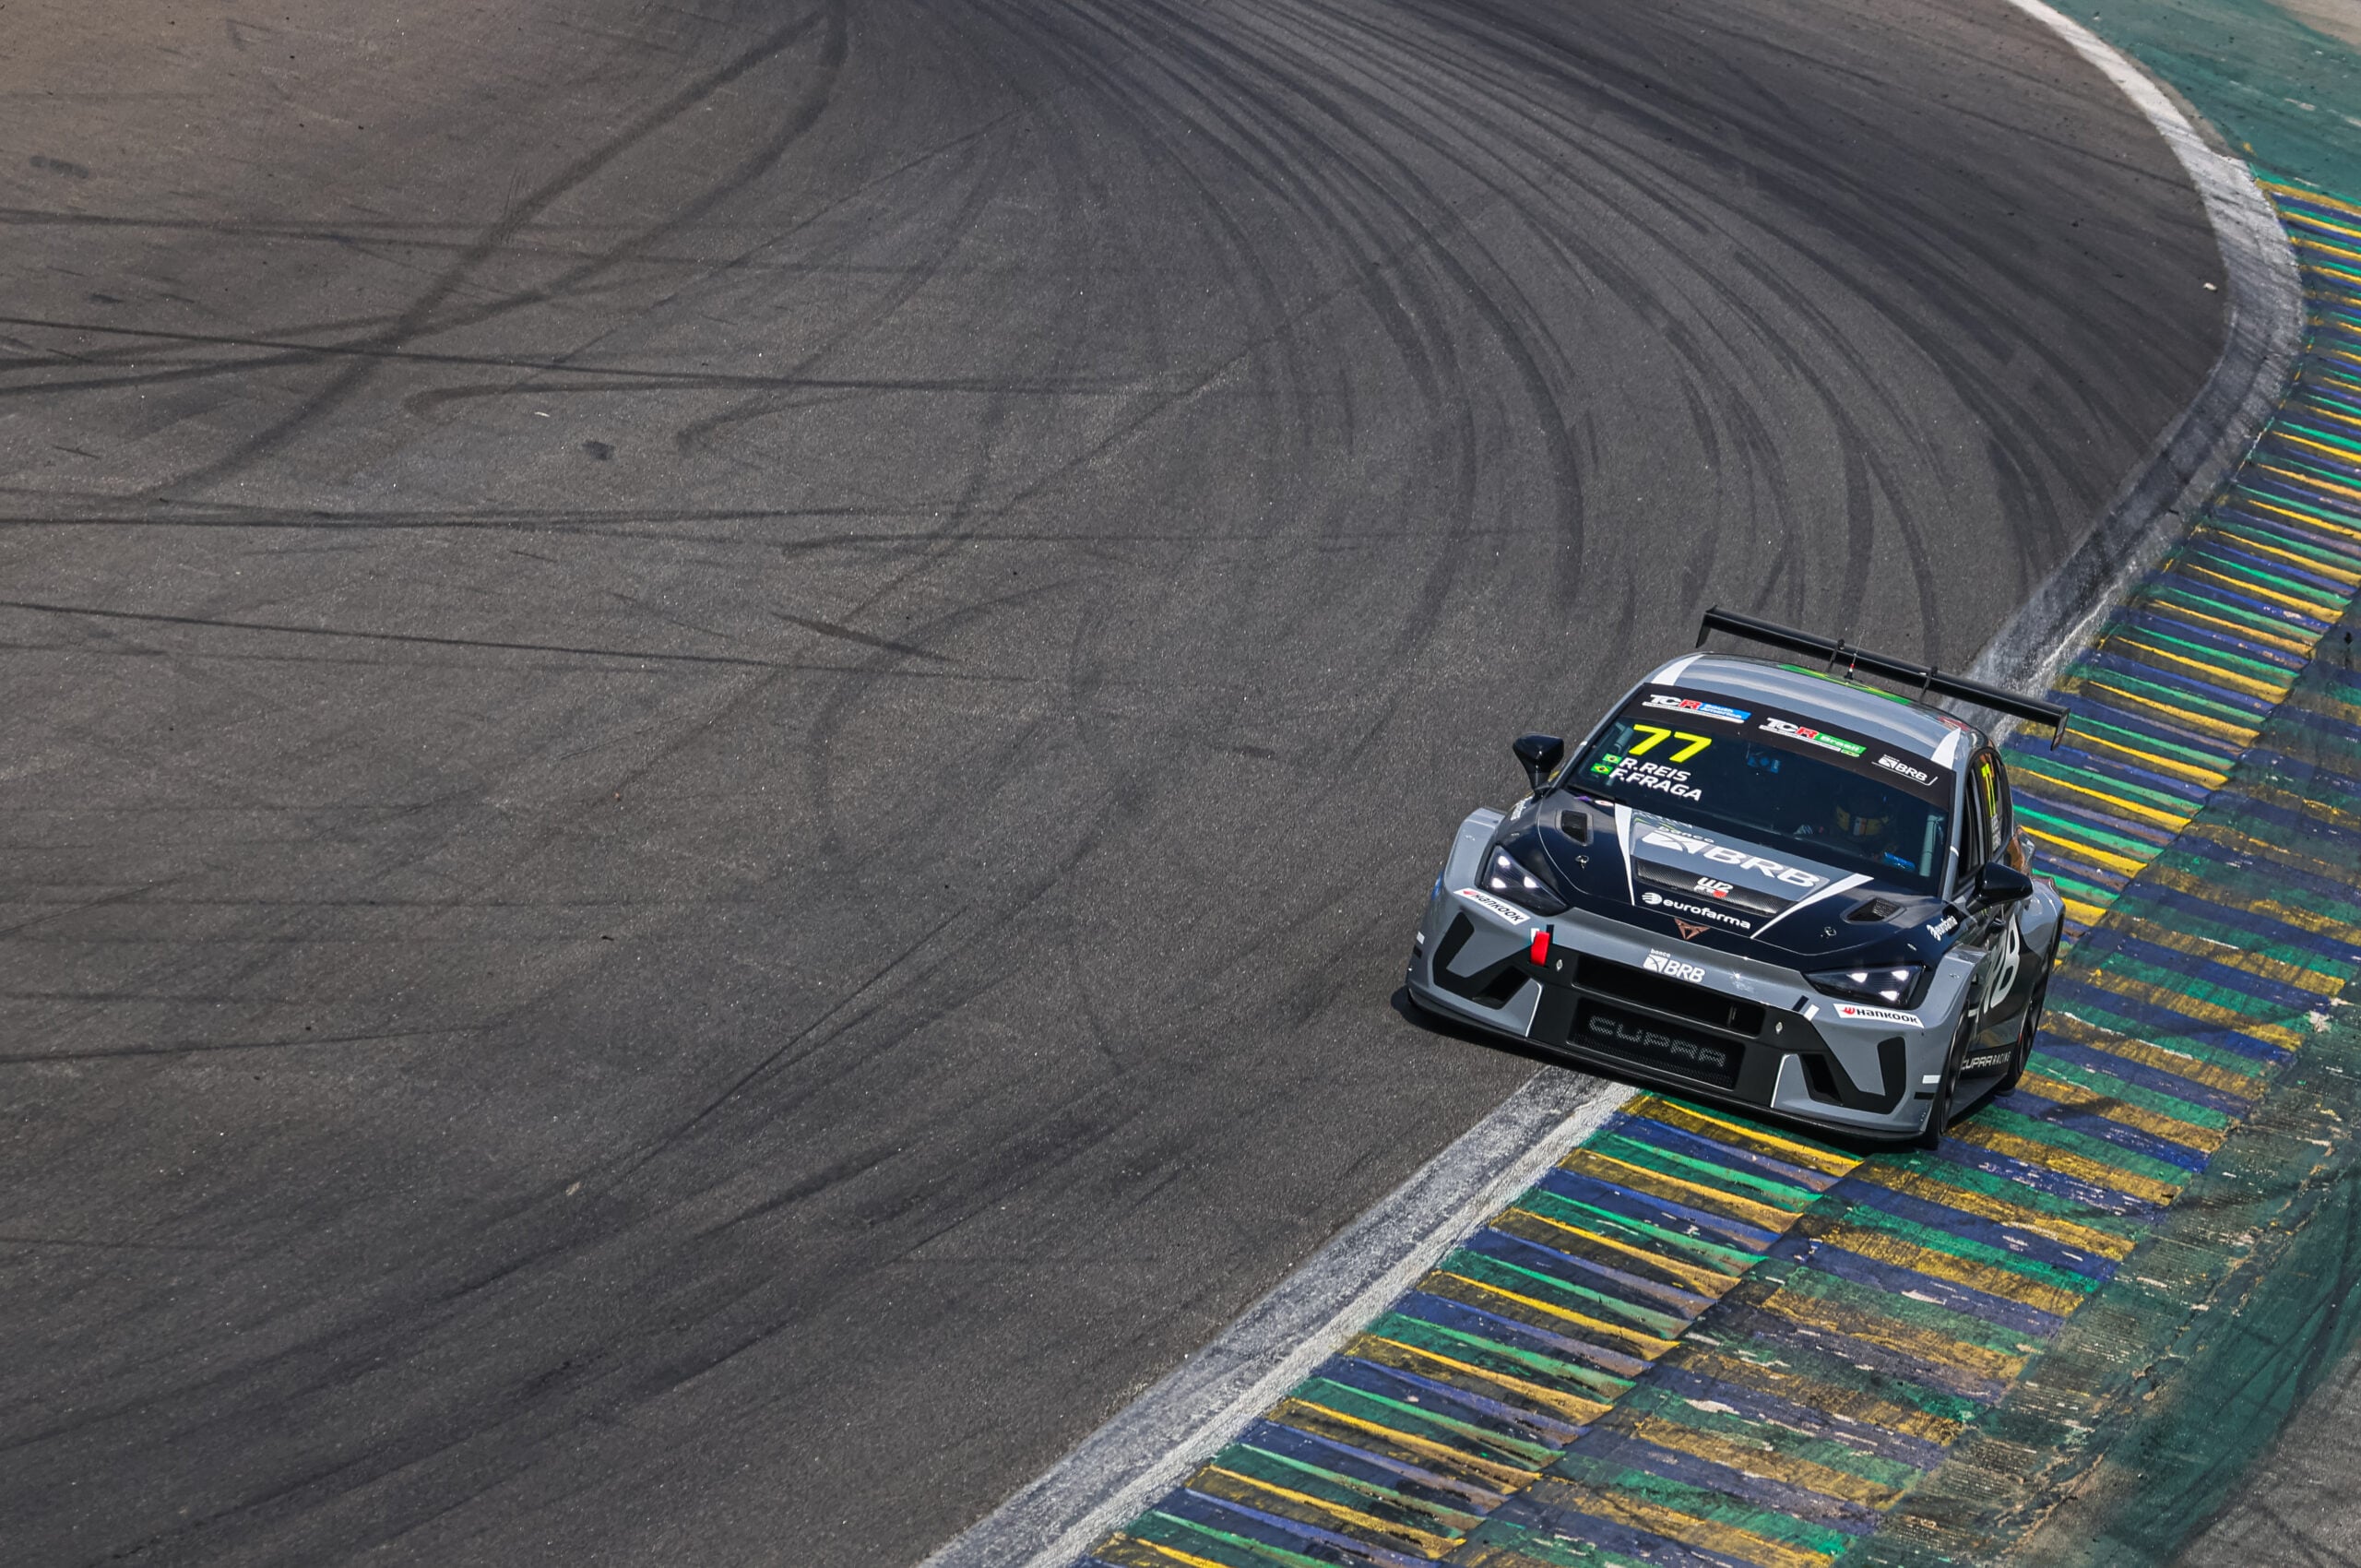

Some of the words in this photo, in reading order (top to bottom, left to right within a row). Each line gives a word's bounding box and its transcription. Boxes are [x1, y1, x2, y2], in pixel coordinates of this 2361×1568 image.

[1650, 694, 1702, 710] TCR
[1766, 717, 1819, 740] TCR
[1629, 724, 1713, 763] 77
[1619, 757, 1691, 782] R.REIS
[1894, 763, 1928, 781] BRB
[1608, 768, 1703, 802] F.FRAGA
[1657, 826, 1714, 843] banco
[1704, 847, 1821, 887] BRB
[1663, 898, 1751, 930] eurofarma
[1664, 960, 1706, 983] BRB
[1589, 1016, 1726, 1067] CUPRA
